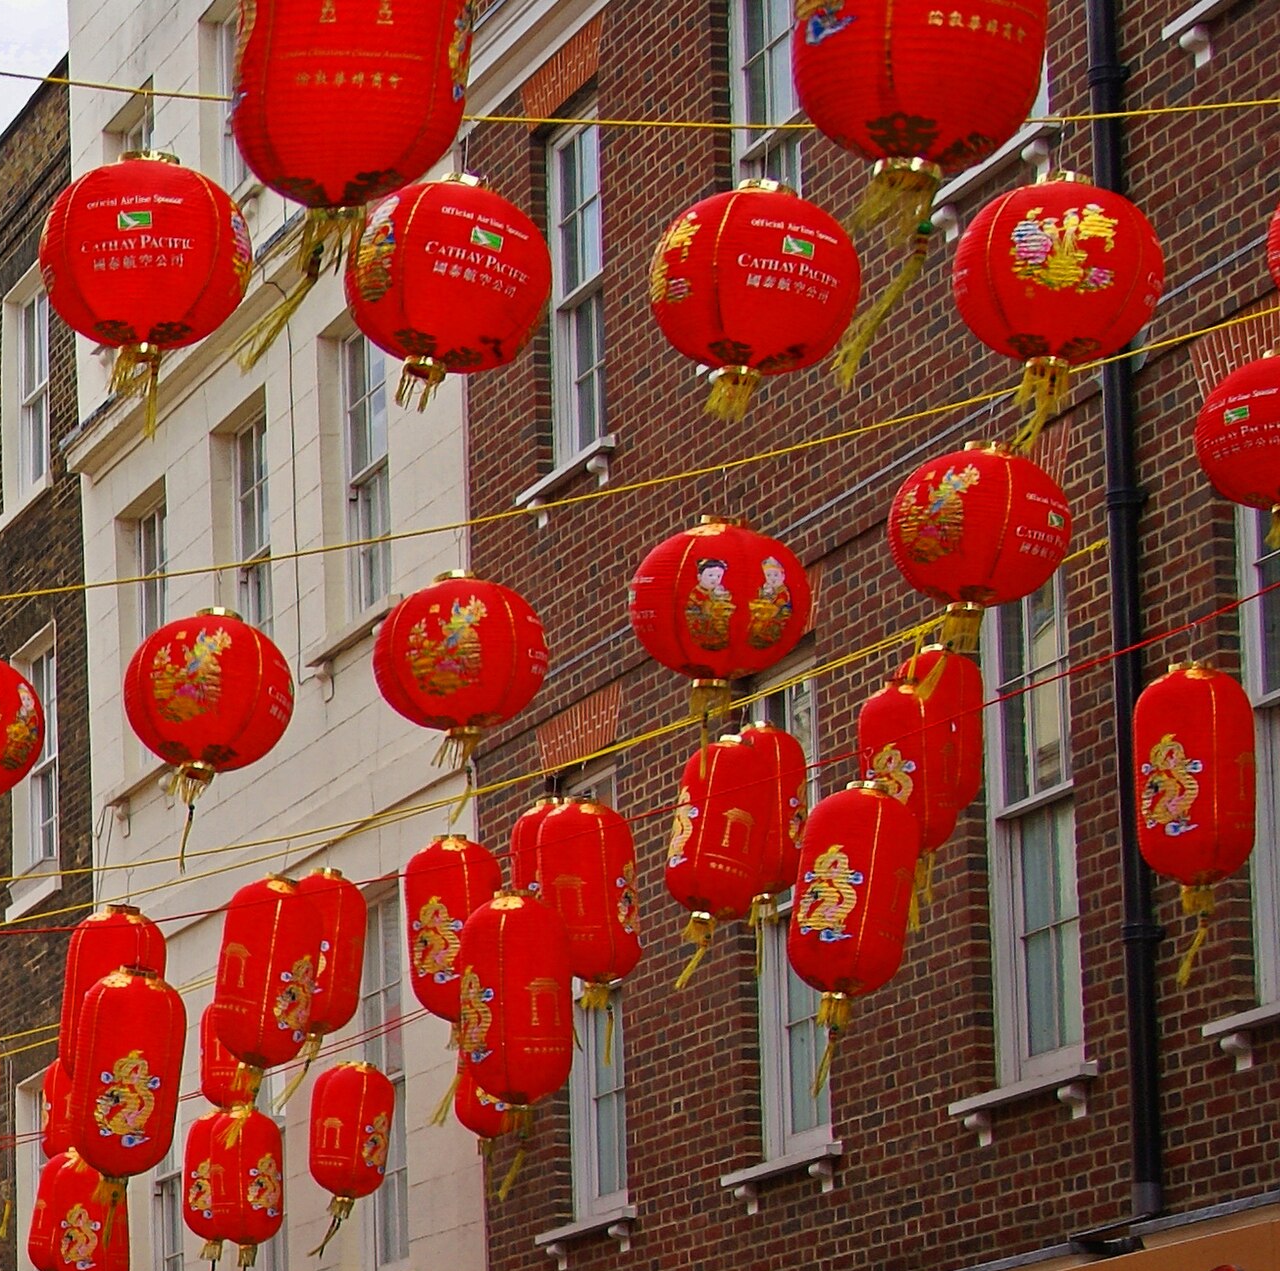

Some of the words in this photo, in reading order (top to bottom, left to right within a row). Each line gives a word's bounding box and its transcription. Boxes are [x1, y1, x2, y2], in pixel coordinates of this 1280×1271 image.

[81, 238, 137, 253] CATHAY
[140, 235, 195, 250] PACIFIC
[425, 240, 483, 265] CATHAY
[485, 255, 530, 286] PACIFIC
[737, 252, 796, 273] CATHAY
[798, 263, 839, 288] PACIFIC
